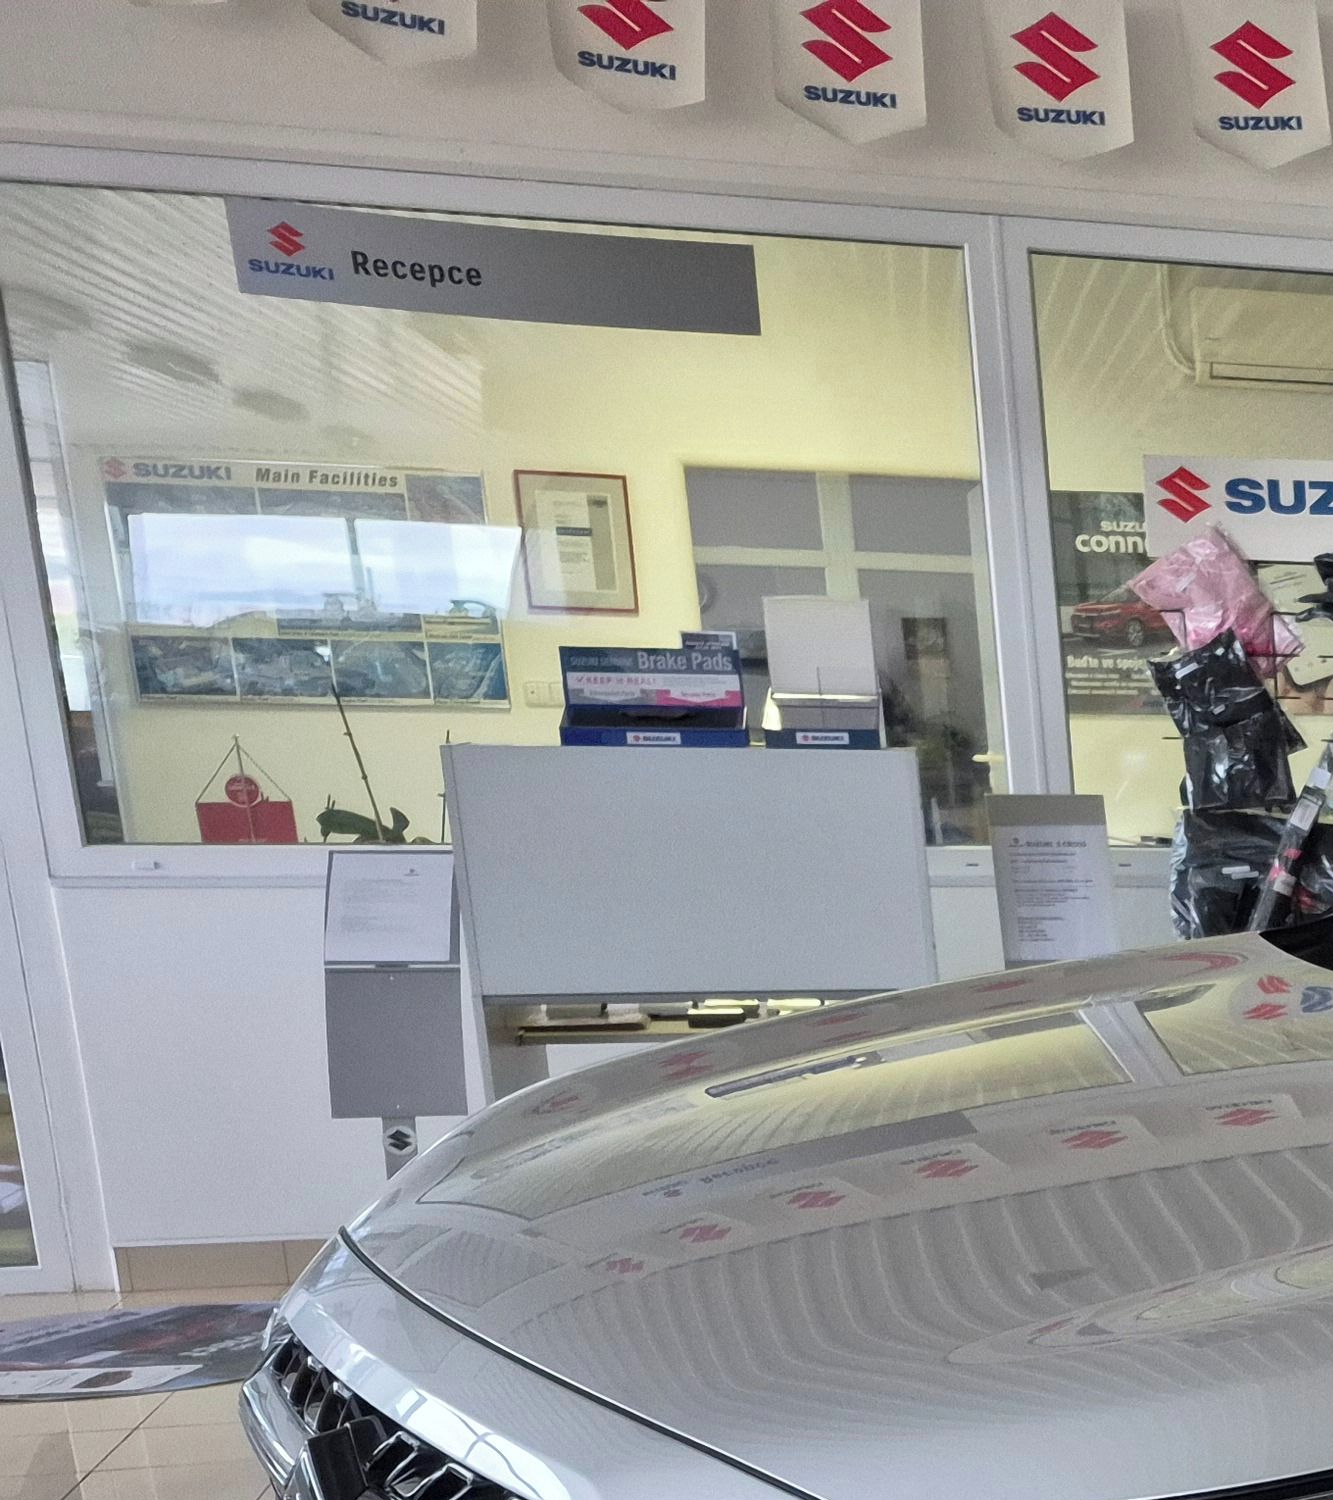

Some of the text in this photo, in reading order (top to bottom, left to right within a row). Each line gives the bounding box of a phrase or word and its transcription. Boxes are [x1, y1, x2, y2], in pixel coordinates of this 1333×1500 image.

[341, 1, 445, 35] SUZUKI
[577, 50, 677, 81] SUZUKI
[803, 85, 897, 109] SUZUKI
[1016, 106, 1106, 127] SUZUKI
[1218, 114, 1303, 132] SUZUKI
[248, 250, 482, 287] SUZUKI Recepce
[132, 462, 398, 487] SUZUKI Main Facilities
[638, 651, 687, 671] Brake
[691, 652, 732, 671] Pads
